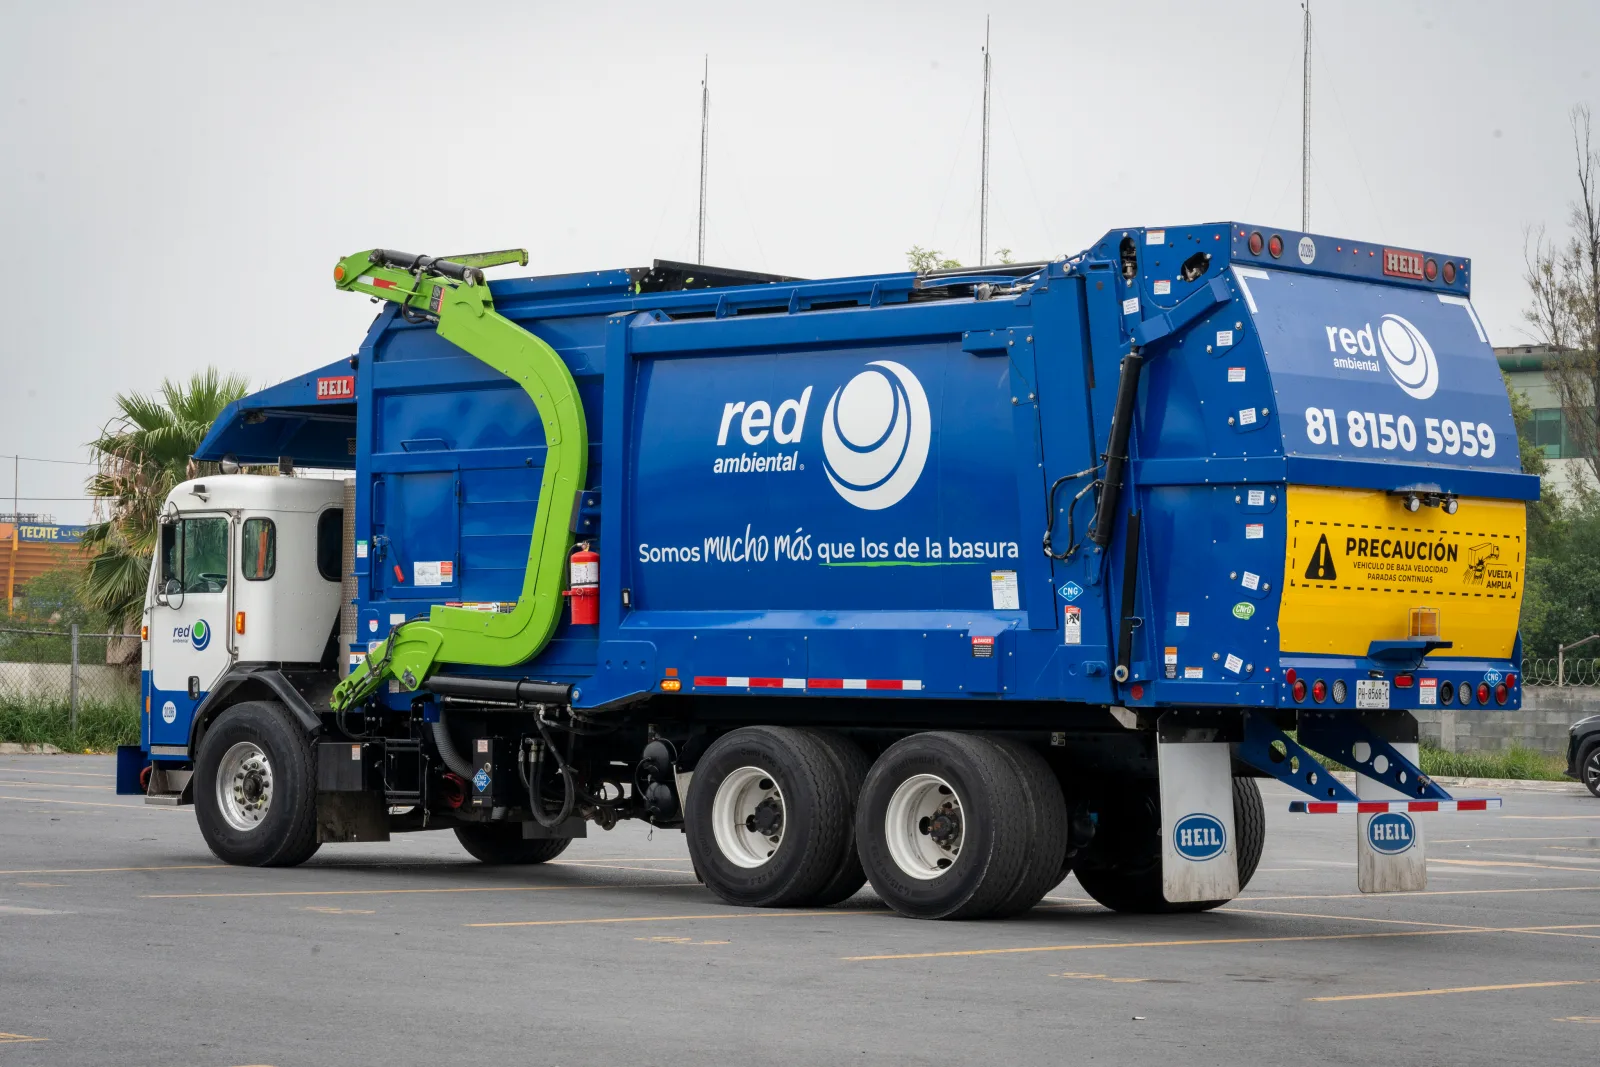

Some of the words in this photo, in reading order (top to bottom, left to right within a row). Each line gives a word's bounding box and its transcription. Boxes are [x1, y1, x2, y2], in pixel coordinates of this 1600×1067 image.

[1387, 253, 1423, 275] HEIL
[1326, 323, 1377, 357] red
[1333, 357, 1381, 372] ambiental
[318, 379, 351, 396] HEIL
[717, 385, 813, 446] red
[1305, 406, 1339, 446] 81
[1347, 410, 1417, 452] 8150
[1424, 417, 1497, 459] 5959
[713, 450, 799, 474] ambiental
[20, 525, 60, 539] TECATE
[639, 543, 700, 563] Somos
[704, 523, 769, 563] mucho
[774, 527, 813, 562] más
[817, 542, 856, 564] que
[861, 537, 889, 559] los
[894, 537, 920, 559] de
[926, 537, 942, 558] la
[949, 537, 1019, 558] basura
[1345, 537, 1459, 563] PRECAUCIÓN
[1353, 561, 1385, 571] VEHICULO
[1386, 563, 1395, 571] DE
[1396, 564, 1412, 573] BAJA
[1414, 565, 1449, 574] VELOCIDAD
[1487, 569, 1513, 580] VUELTA
[1367, 572, 1397, 582] PARADAS
[1398, 574, 1434, 584] CONTINUAS
[1486, 580, 1512, 590] AMPLIA
[1062, 587, 1079, 596] CNG
[173, 625, 191, 638] red
[1487, 673, 1499, 682] CNG
[1180, 828, 1221, 847] HEIL
[1373, 823, 1410, 841] HEIL
